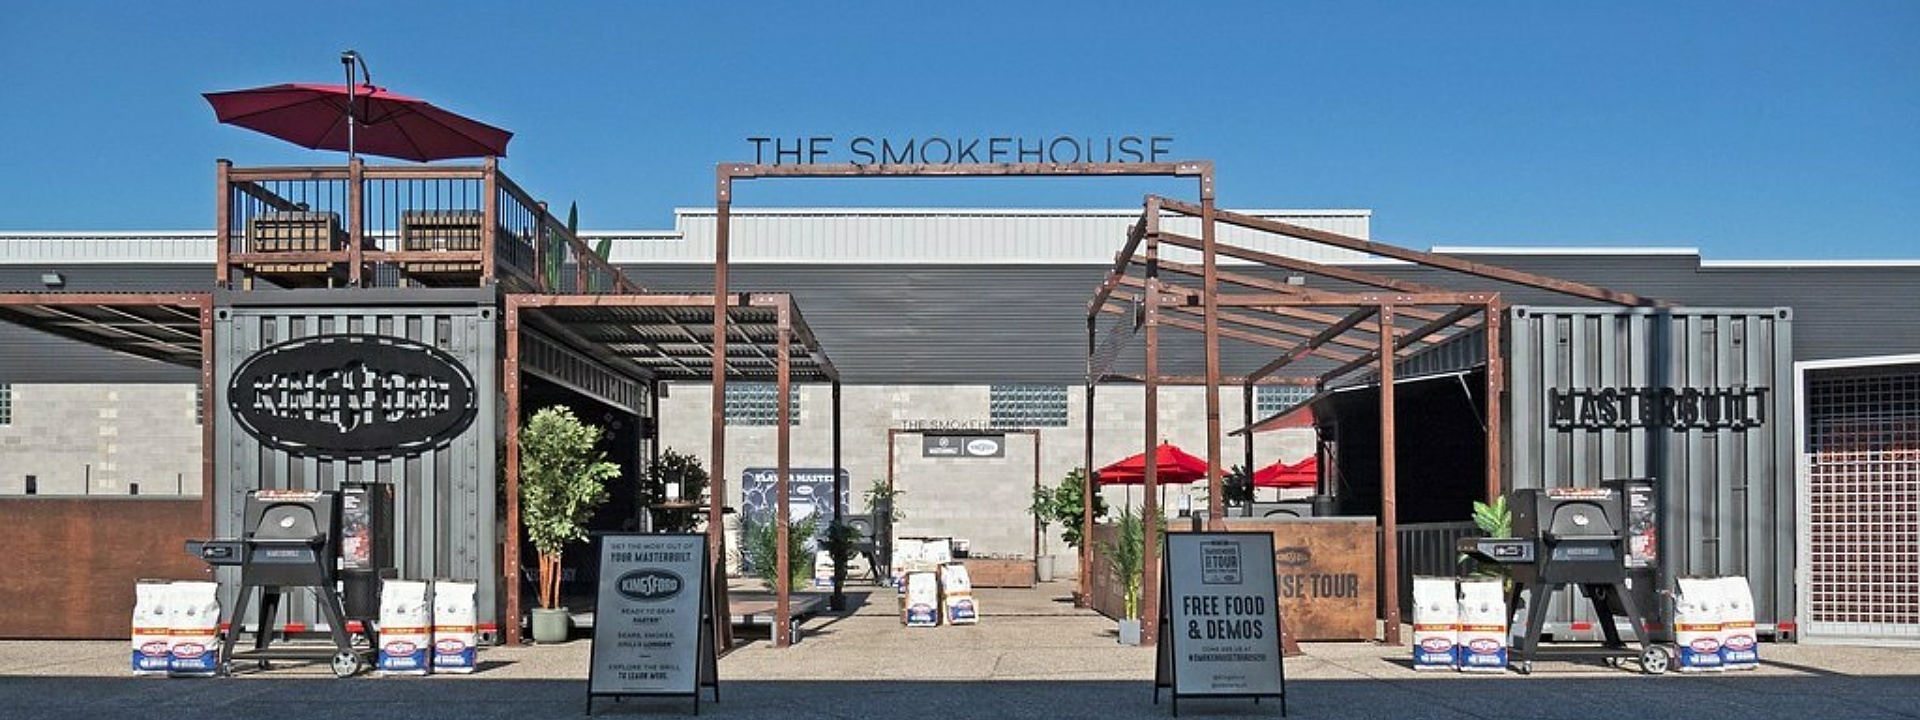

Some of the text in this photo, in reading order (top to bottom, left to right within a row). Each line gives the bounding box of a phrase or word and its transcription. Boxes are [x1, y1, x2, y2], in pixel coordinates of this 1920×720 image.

[747, 136, 1175, 165] THE SMOKEHOUSE
[1548, 387, 1770, 430] MASTERBUILT
[611, 552, 632, 563] YOUR
[621, 574, 678, 595] KINGSFORD
[1310, 573, 1358, 598] TOUR
[1182, 595, 1265, 616] FREE FOOD
[1188, 619, 1263, 640] & DEMOS
